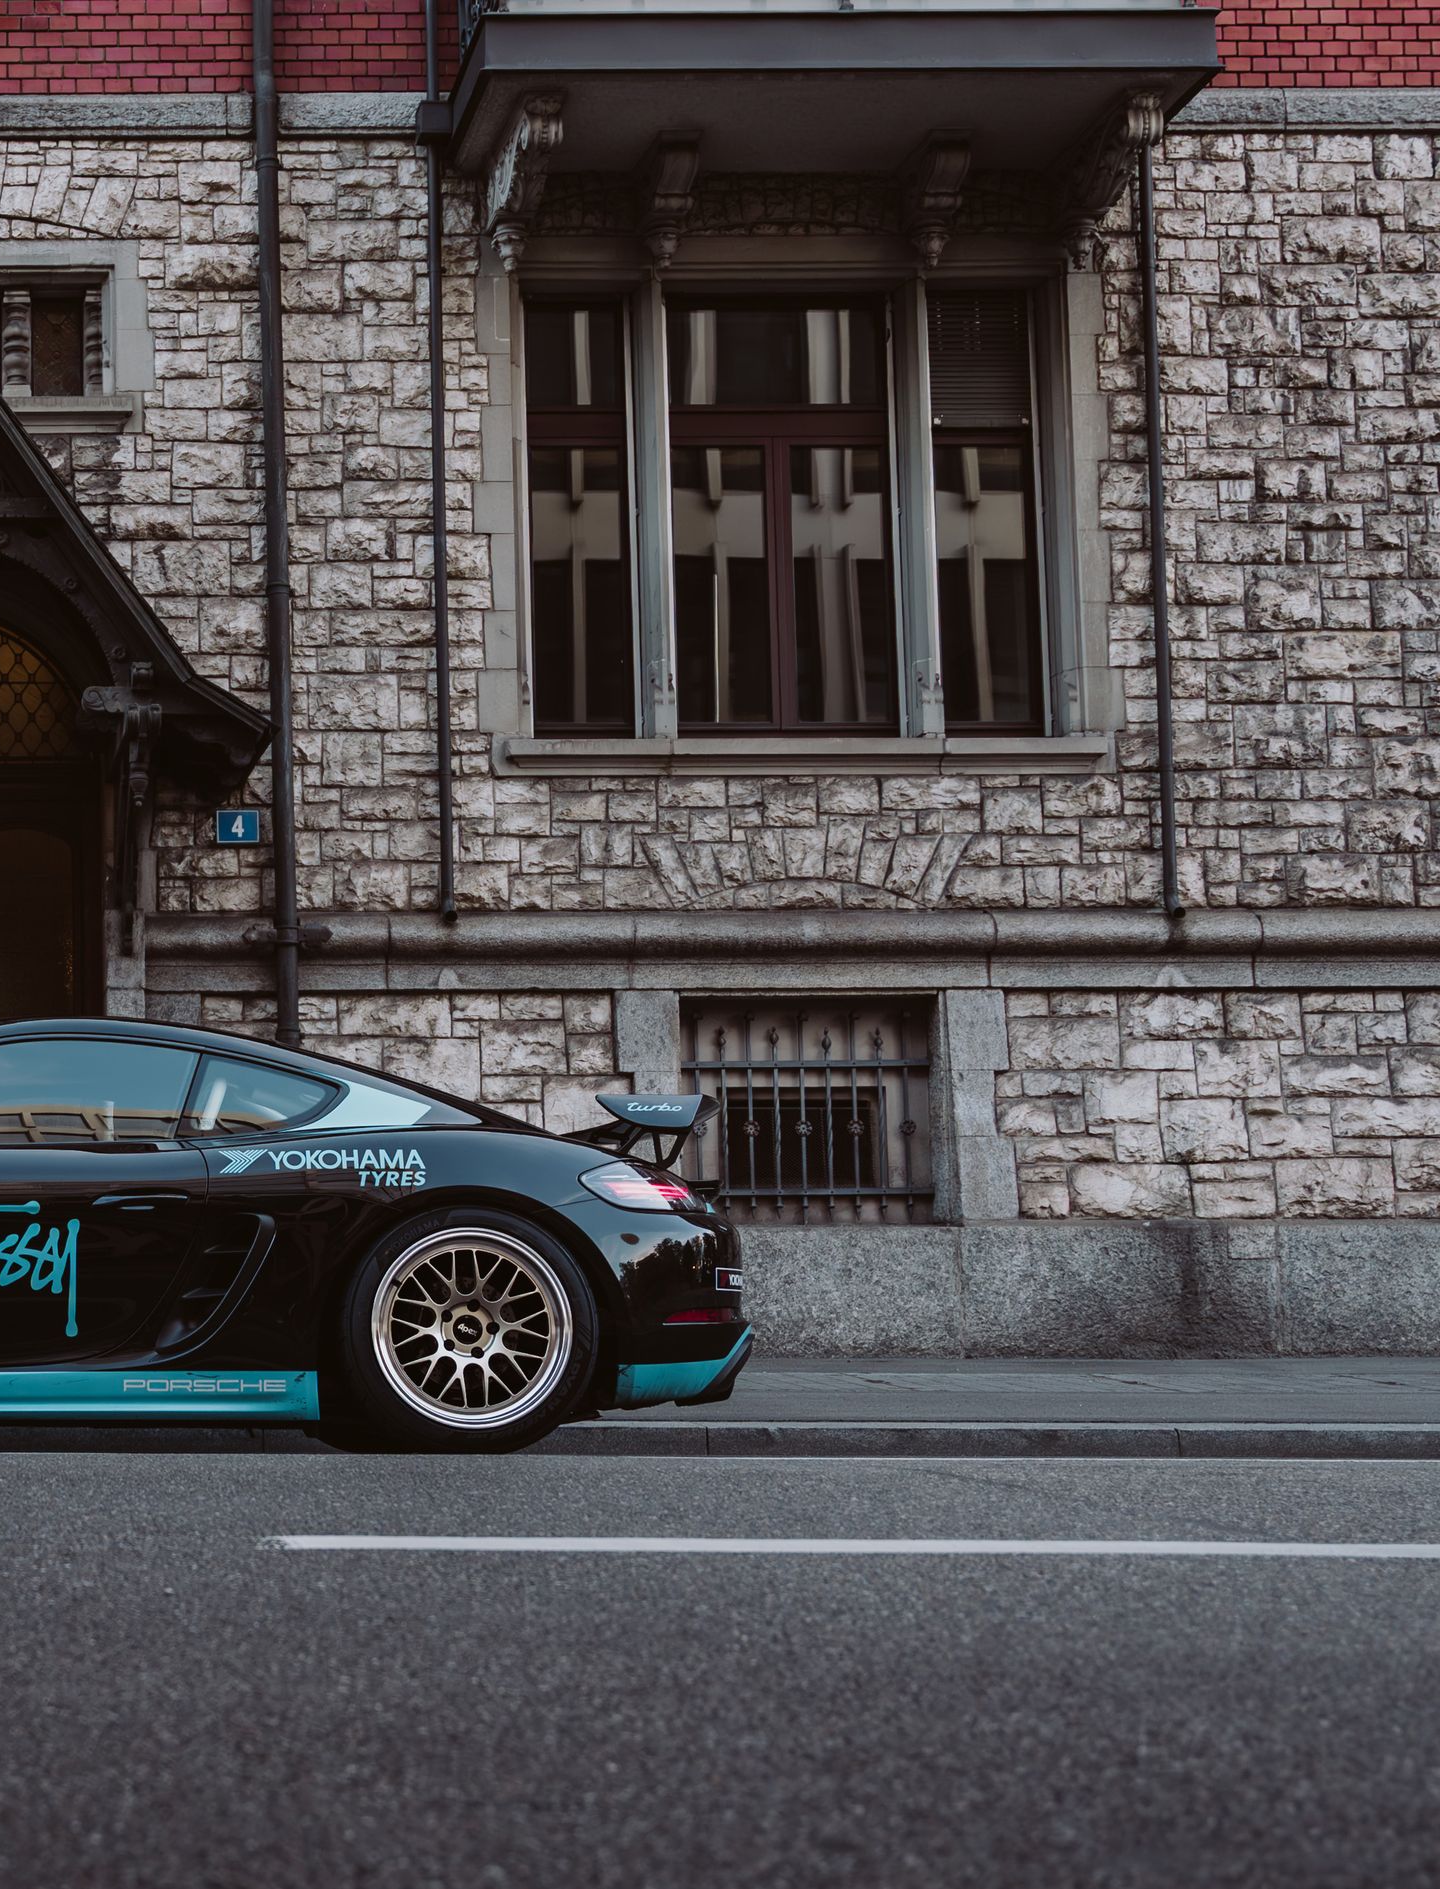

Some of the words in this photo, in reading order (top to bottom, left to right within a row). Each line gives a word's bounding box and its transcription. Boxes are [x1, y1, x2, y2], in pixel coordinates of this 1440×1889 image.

[231, 815, 245, 838] 4
[627, 1102, 683, 1112] turbo
[267, 1149, 426, 1170] YOKOHAMA
[358, 1171, 426, 1187] TYRES
[123, 1379, 287, 1393] PORSCHE
